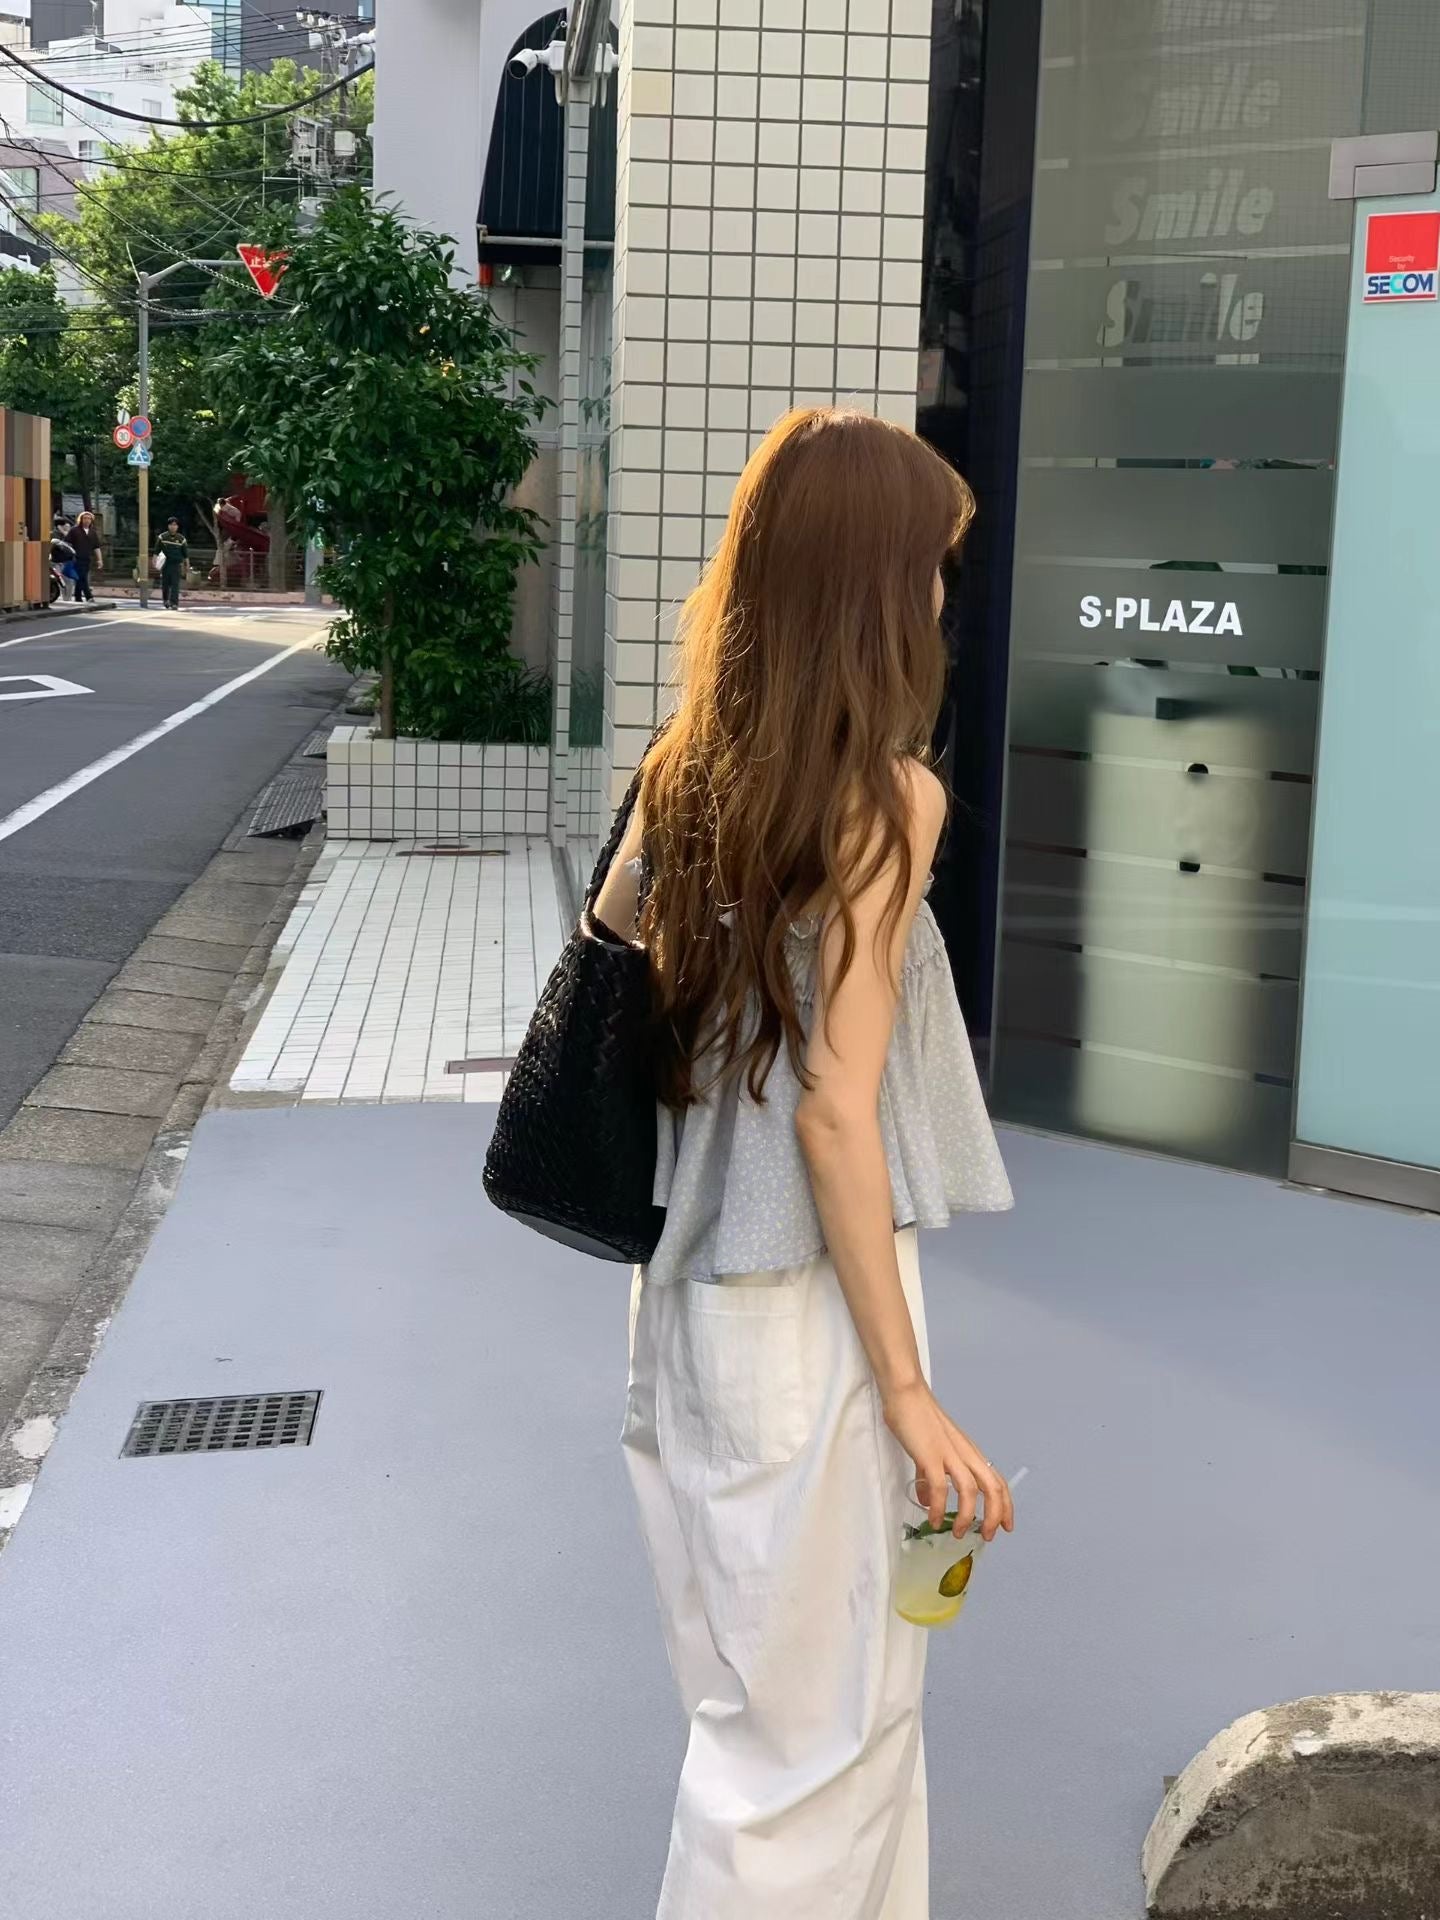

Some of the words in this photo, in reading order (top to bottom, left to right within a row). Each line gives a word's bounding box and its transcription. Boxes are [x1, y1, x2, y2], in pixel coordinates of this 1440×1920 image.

[1104, 168, 1274, 246] Smile
[1368, 274, 1433, 294] SECOM
[119, 432, 128, 441] 30
